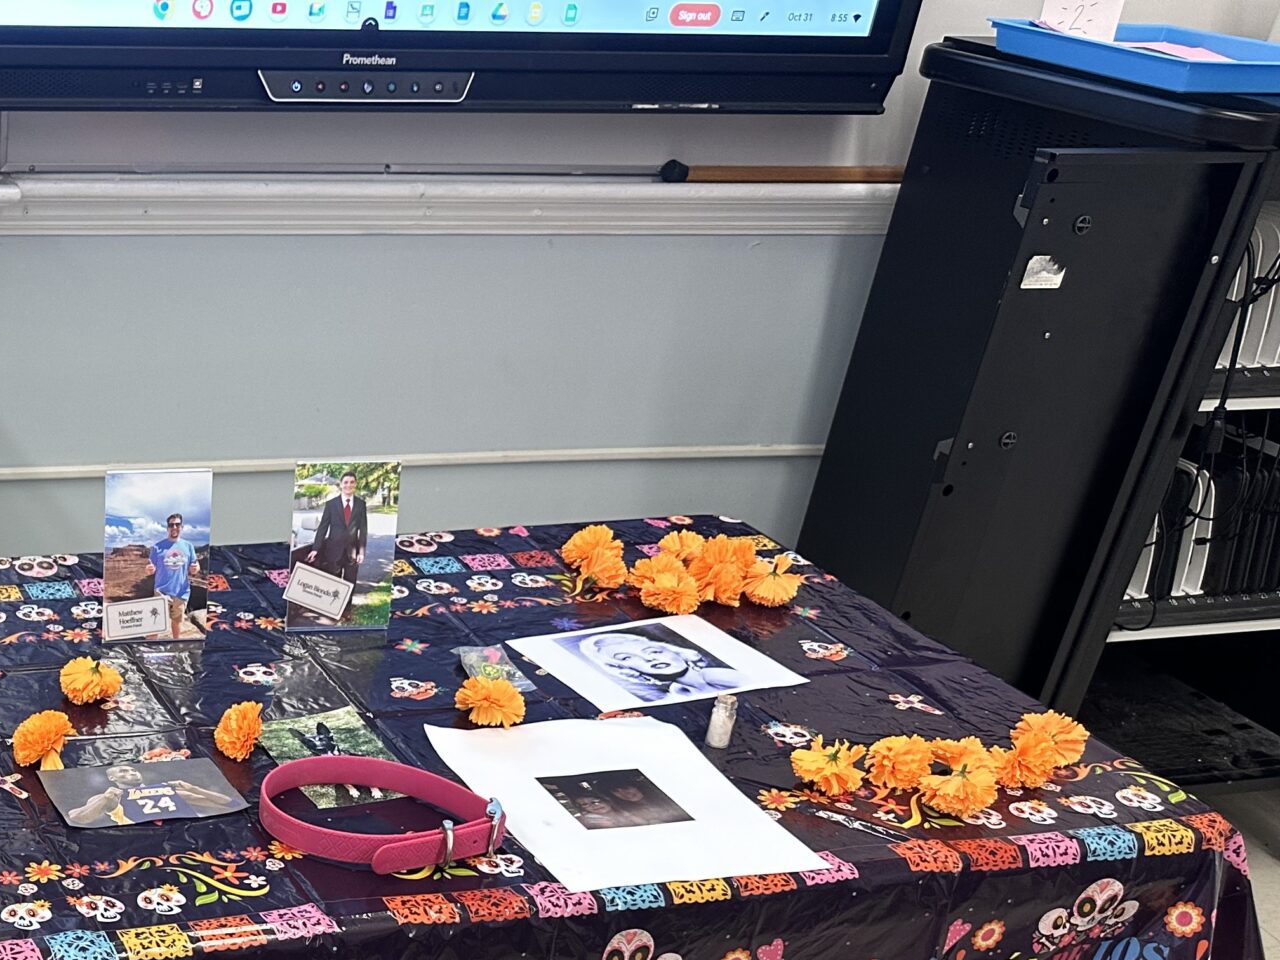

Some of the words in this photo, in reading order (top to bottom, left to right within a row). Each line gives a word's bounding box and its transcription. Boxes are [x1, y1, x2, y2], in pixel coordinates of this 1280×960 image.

[677, 9, 697, 21] Sign
[697, 11, 712, 21] out
[787, 12, 803, 22] Oct
[803, 13, 813, 22] 31
[830, 13, 848, 23] 8:55
[342, 53, 397, 66] Promethean
[136, 796, 177, 814] 24
